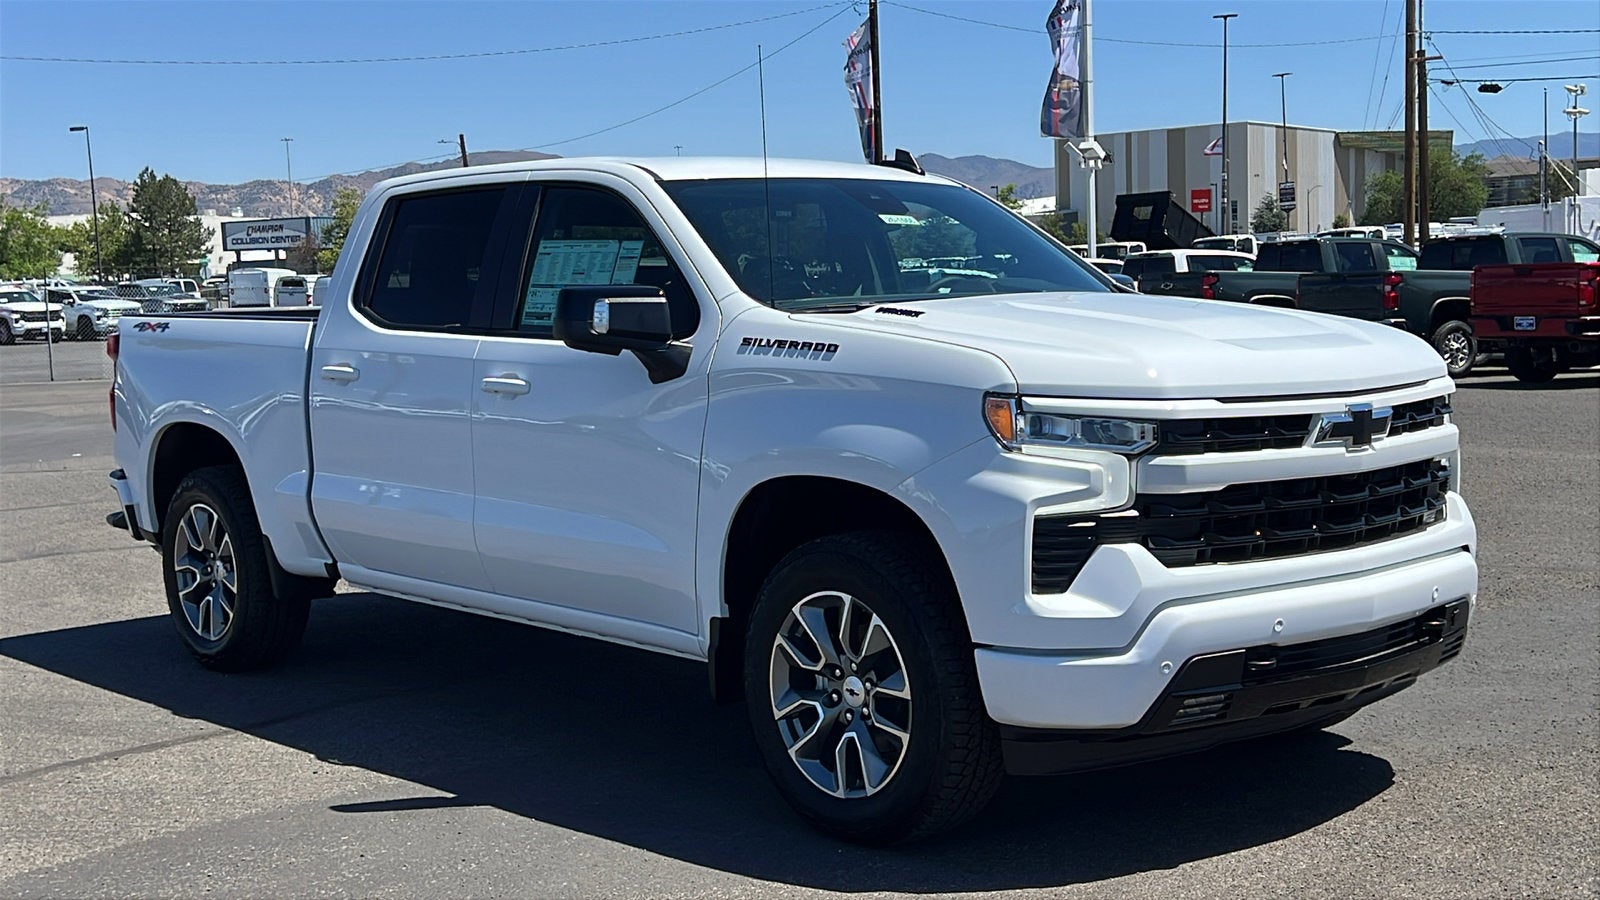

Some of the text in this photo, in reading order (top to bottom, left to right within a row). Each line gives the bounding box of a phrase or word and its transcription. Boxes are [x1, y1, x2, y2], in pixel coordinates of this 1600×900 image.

[246, 224, 284, 237] CHAMPION
[231, 235, 301, 245] COLLISION CENTER
[740, 337, 840, 353] SILVERADO
